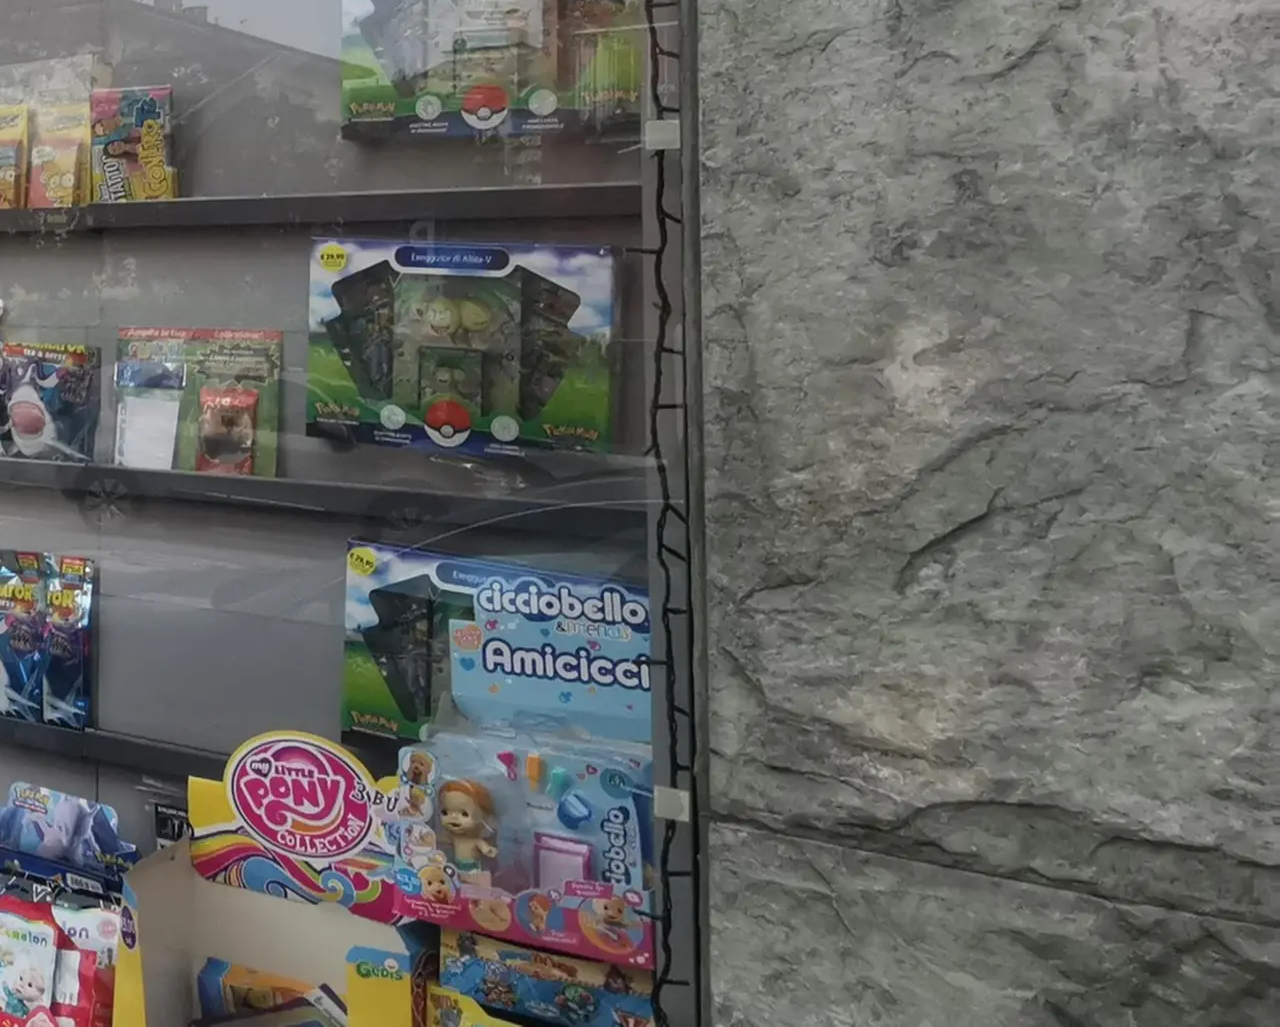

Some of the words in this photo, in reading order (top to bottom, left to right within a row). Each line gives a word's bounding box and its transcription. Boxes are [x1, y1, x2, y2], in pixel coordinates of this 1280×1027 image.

[479, 583, 647, 624] cicciobello
[485, 640, 651, 691] Amicicci
[275, 766, 316, 779] LITTLE
[243, 775, 342, 811] PONY
[277, 815, 366, 855] COLLECTION
